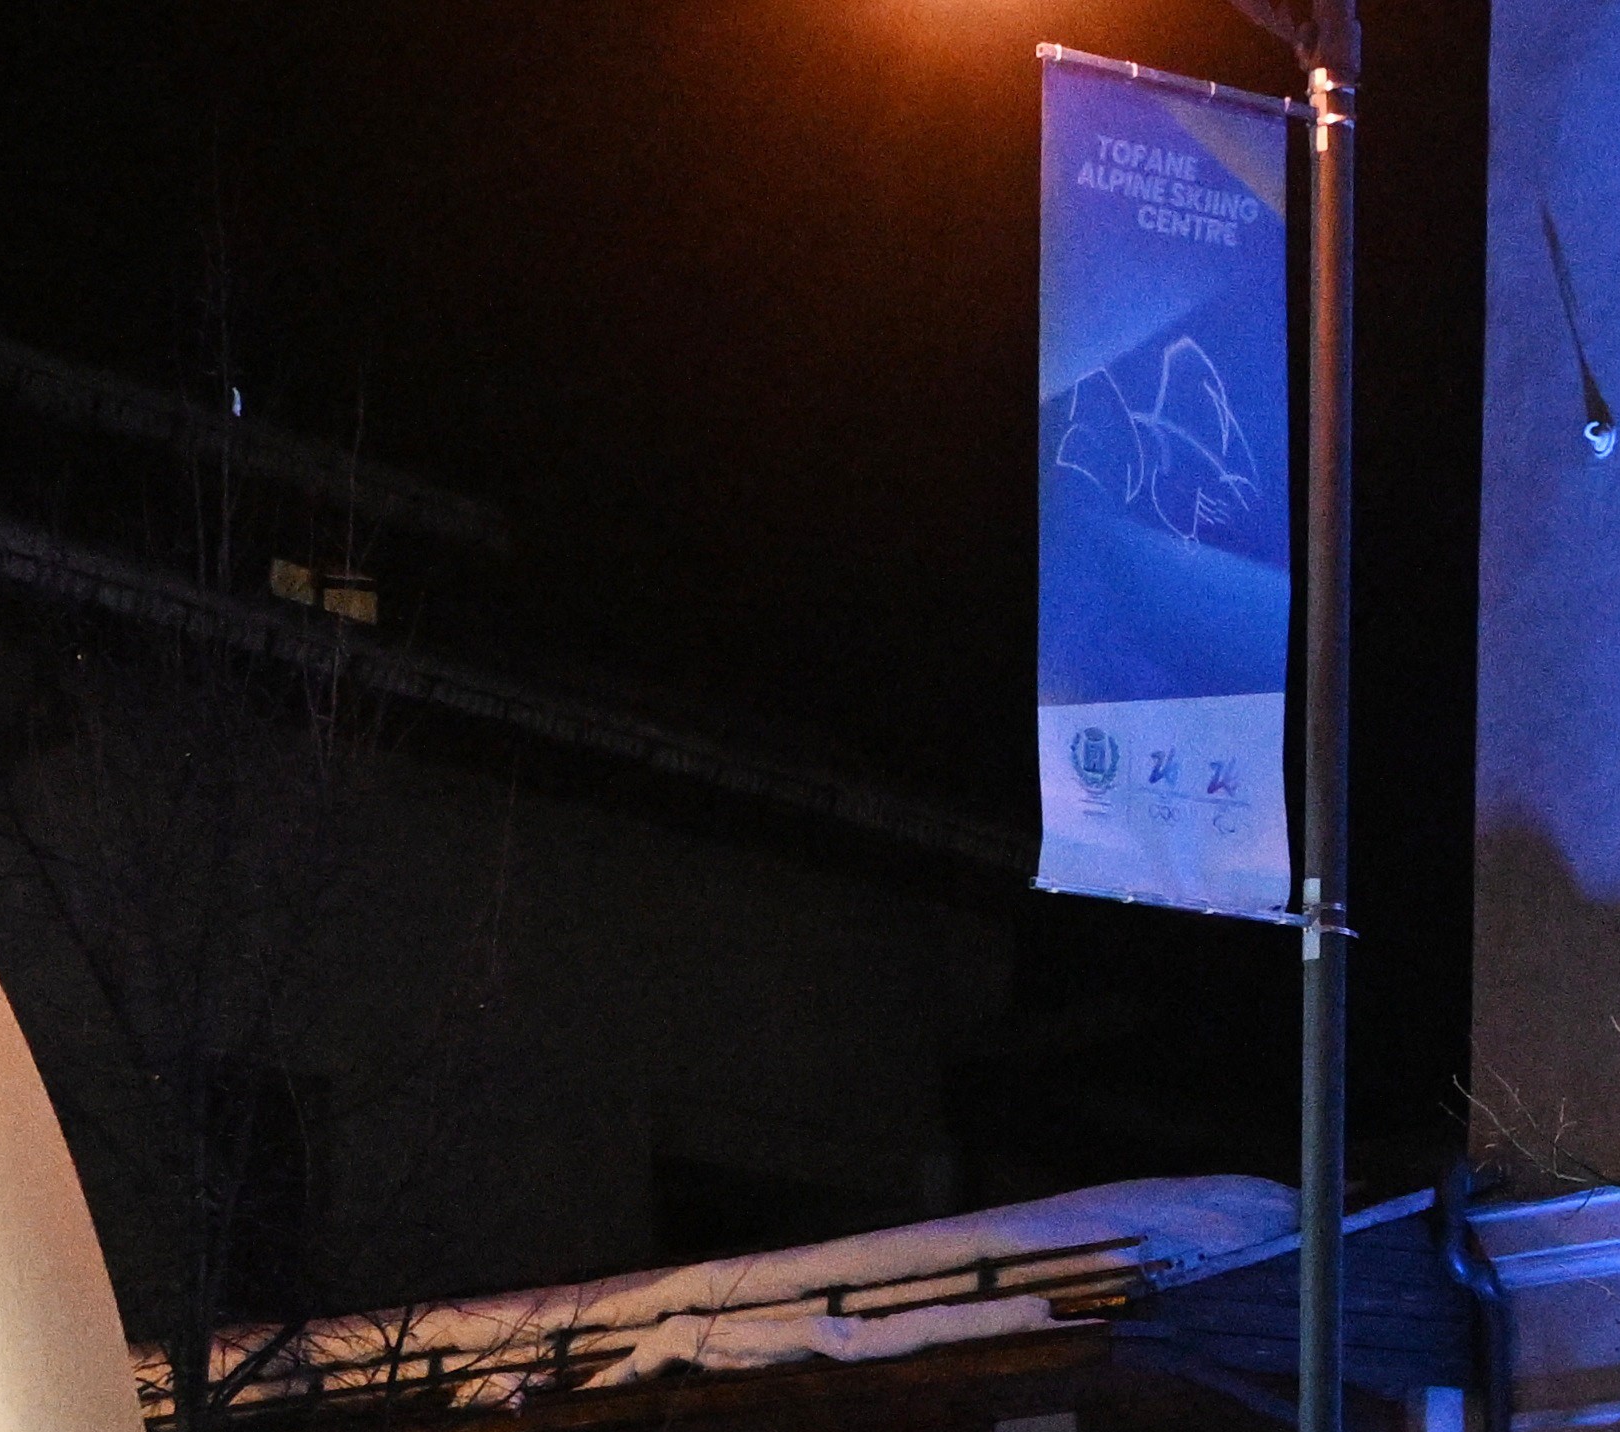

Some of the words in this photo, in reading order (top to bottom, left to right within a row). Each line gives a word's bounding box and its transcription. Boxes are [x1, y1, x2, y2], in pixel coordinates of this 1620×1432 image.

[1097, 134, 1198, 182] TOFANE
[1077, 161, 1167, 203] ALPINE
[1169, 182, 1260, 225] SKIING
[1137, 204, 1238, 247] CENTRE
